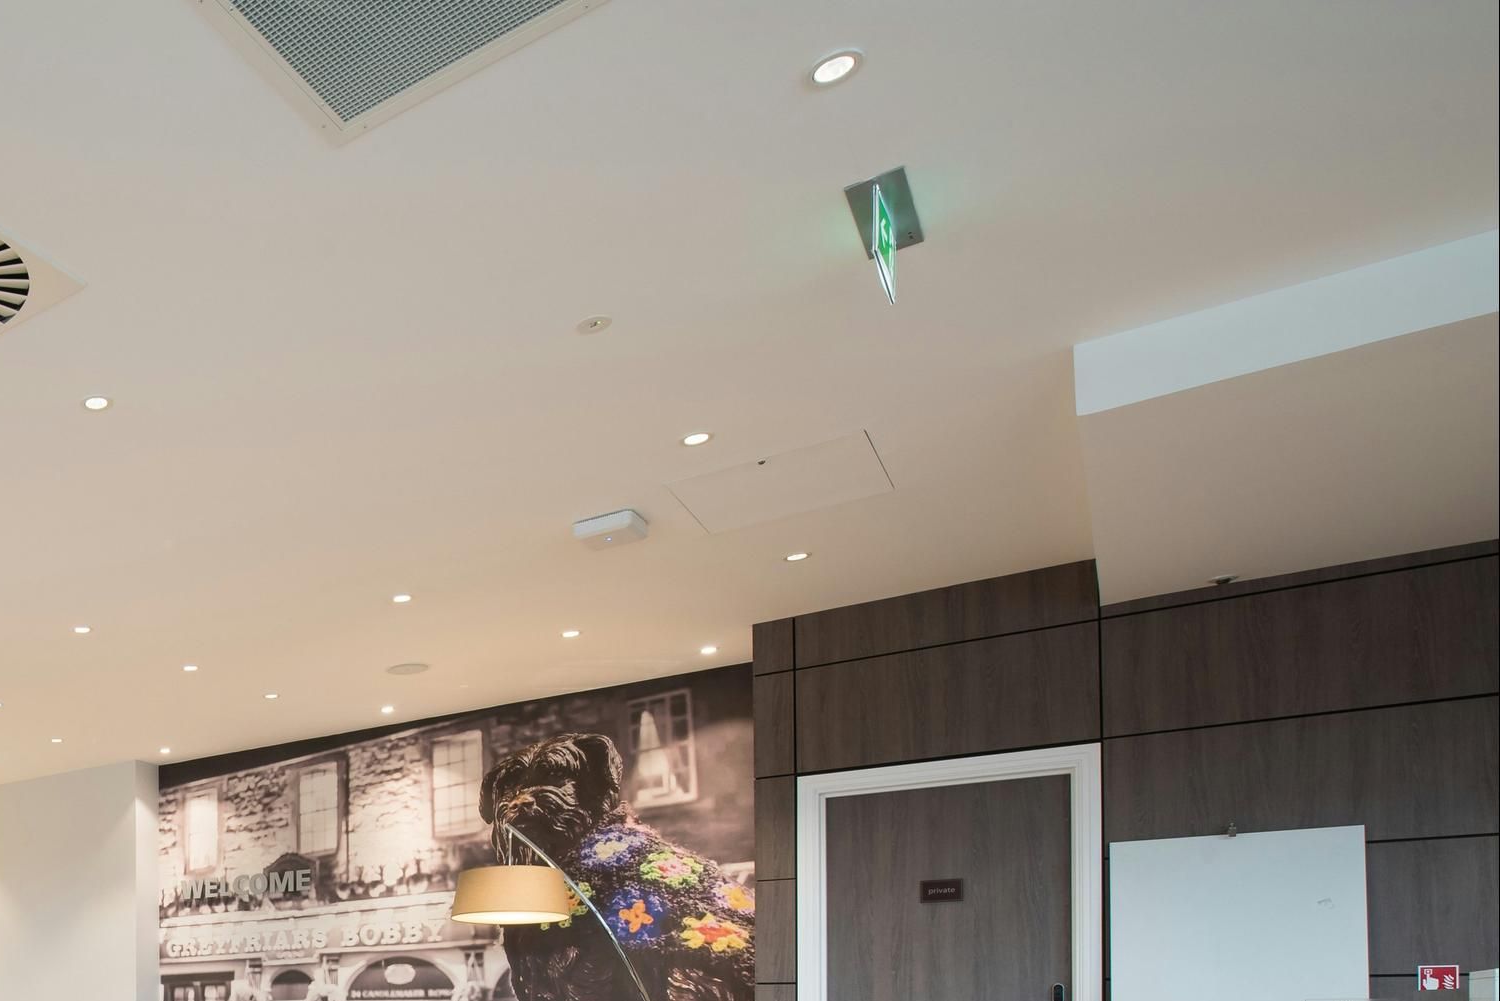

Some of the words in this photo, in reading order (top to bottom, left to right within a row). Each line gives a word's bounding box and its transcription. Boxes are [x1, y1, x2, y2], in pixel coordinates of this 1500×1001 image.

[181, 869, 311, 900] WELCOME
[928, 887, 956, 896] private
[166, 928, 327, 958] GREYFRIARS
[340, 920, 445, 947] BOBBY
